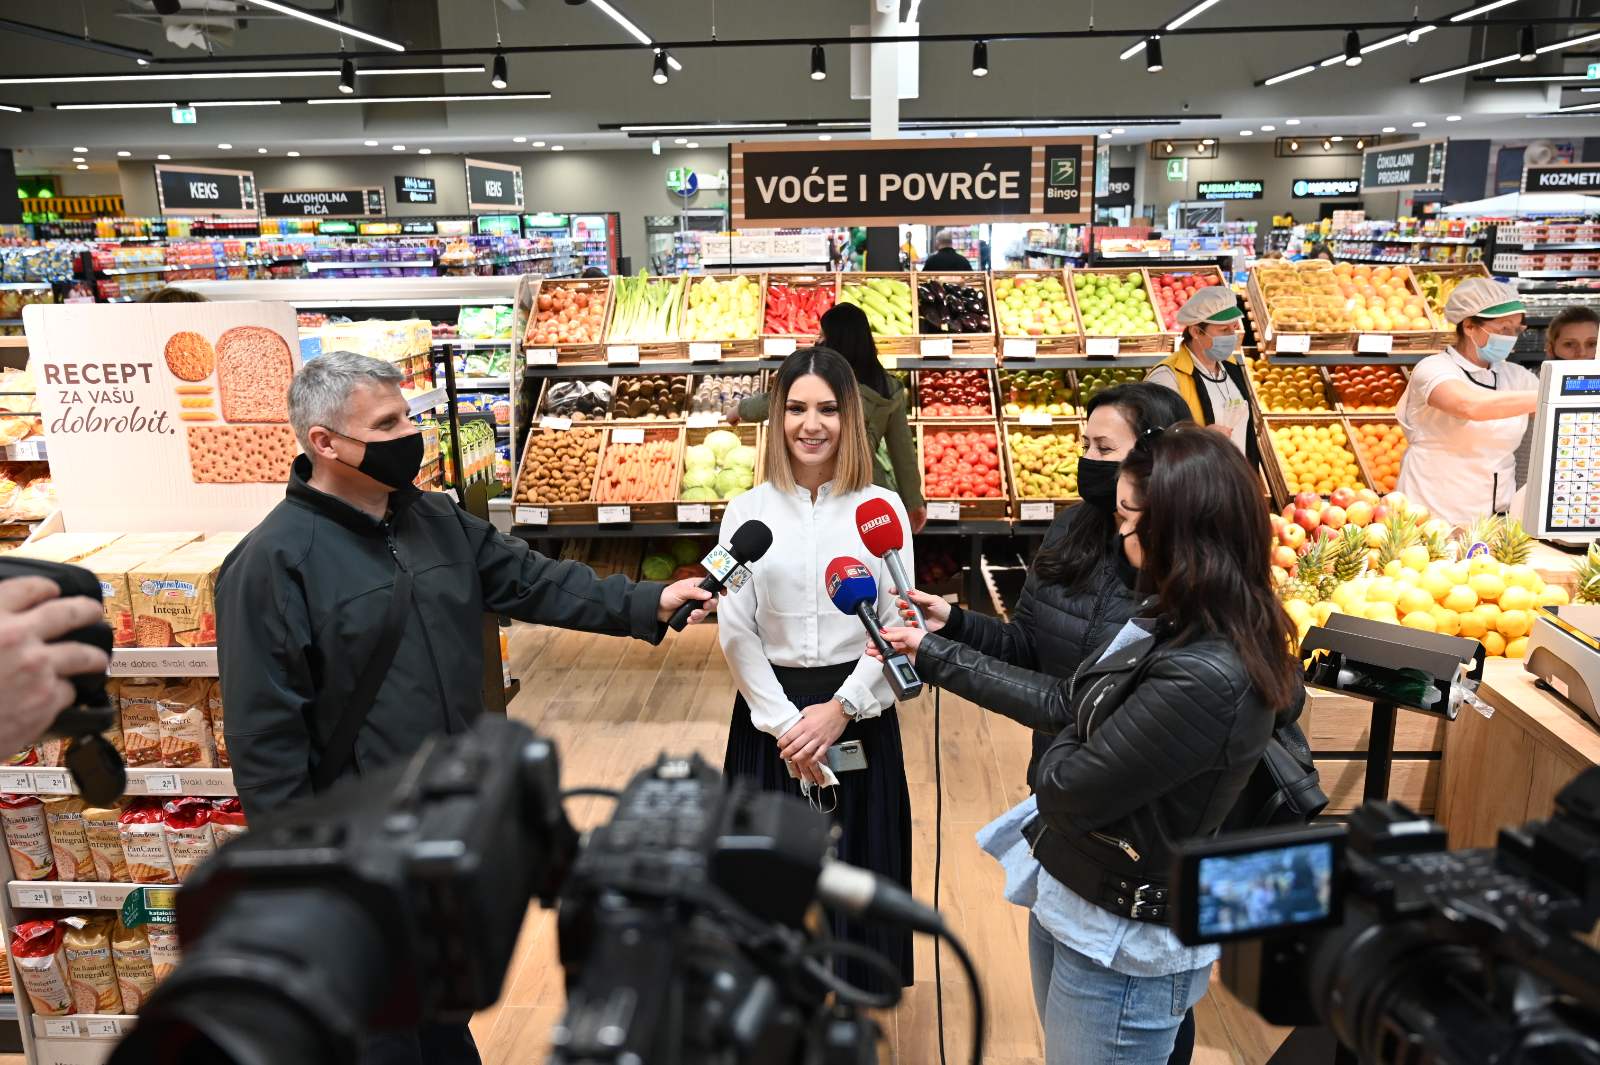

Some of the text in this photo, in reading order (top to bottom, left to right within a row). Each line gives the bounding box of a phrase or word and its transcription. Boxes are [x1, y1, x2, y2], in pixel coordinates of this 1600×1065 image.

[1377, 153, 1414, 169] ČOKOLADNI
[755, 163, 1021, 204] VOĆE I POVRĆE
[1378, 170, 1410, 184] PROGRAM
[189, 182, 219, 199] KEKS
[485, 180, 503, 197] KEKS
[1047, 187, 1078, 200] Bingo
[1108, 182, 1130, 192] ngo
[282, 193, 348, 204] ALKOHOLNA
[304, 202, 329, 214] PIĆA
[44, 362, 153, 385] RECEPT
[59, 387, 135, 404] ZA VAŠU
[50, 406, 176, 435] dobrobit.
[153, 605, 192, 616] Integrali
[73, 970, 109, 979] Integrale
